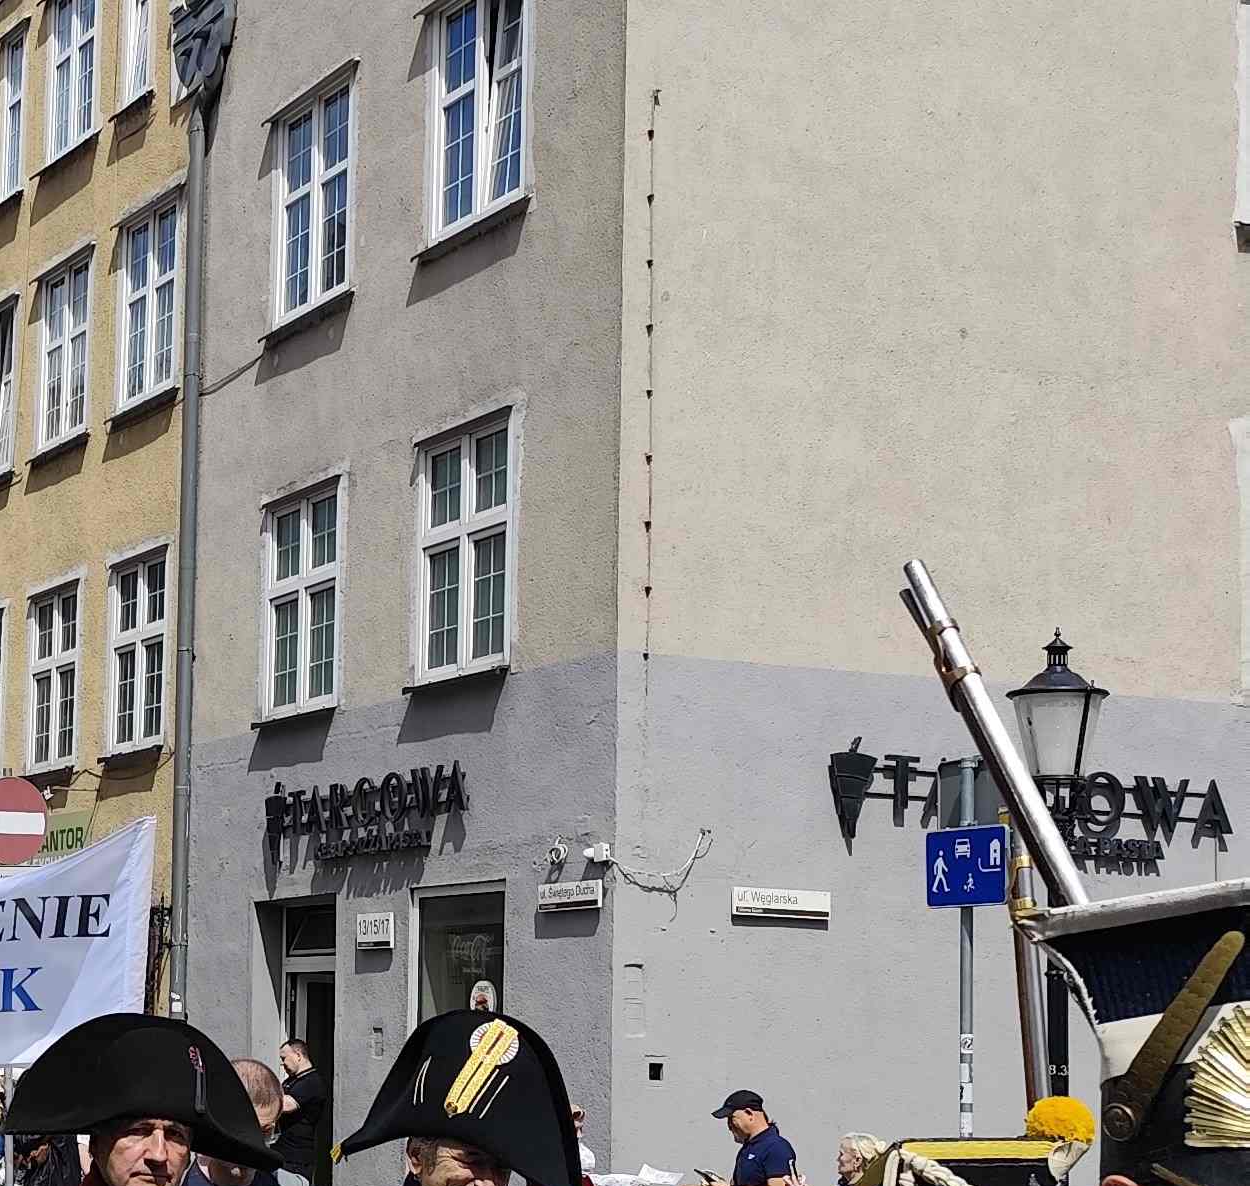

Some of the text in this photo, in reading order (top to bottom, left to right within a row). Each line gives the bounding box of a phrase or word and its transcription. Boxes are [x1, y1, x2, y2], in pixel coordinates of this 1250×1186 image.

[37, 826, 84, 853] ANTOR
[751, 891, 798, 906] Węglarska
[358, 918, 390, 936] 13/15/17
